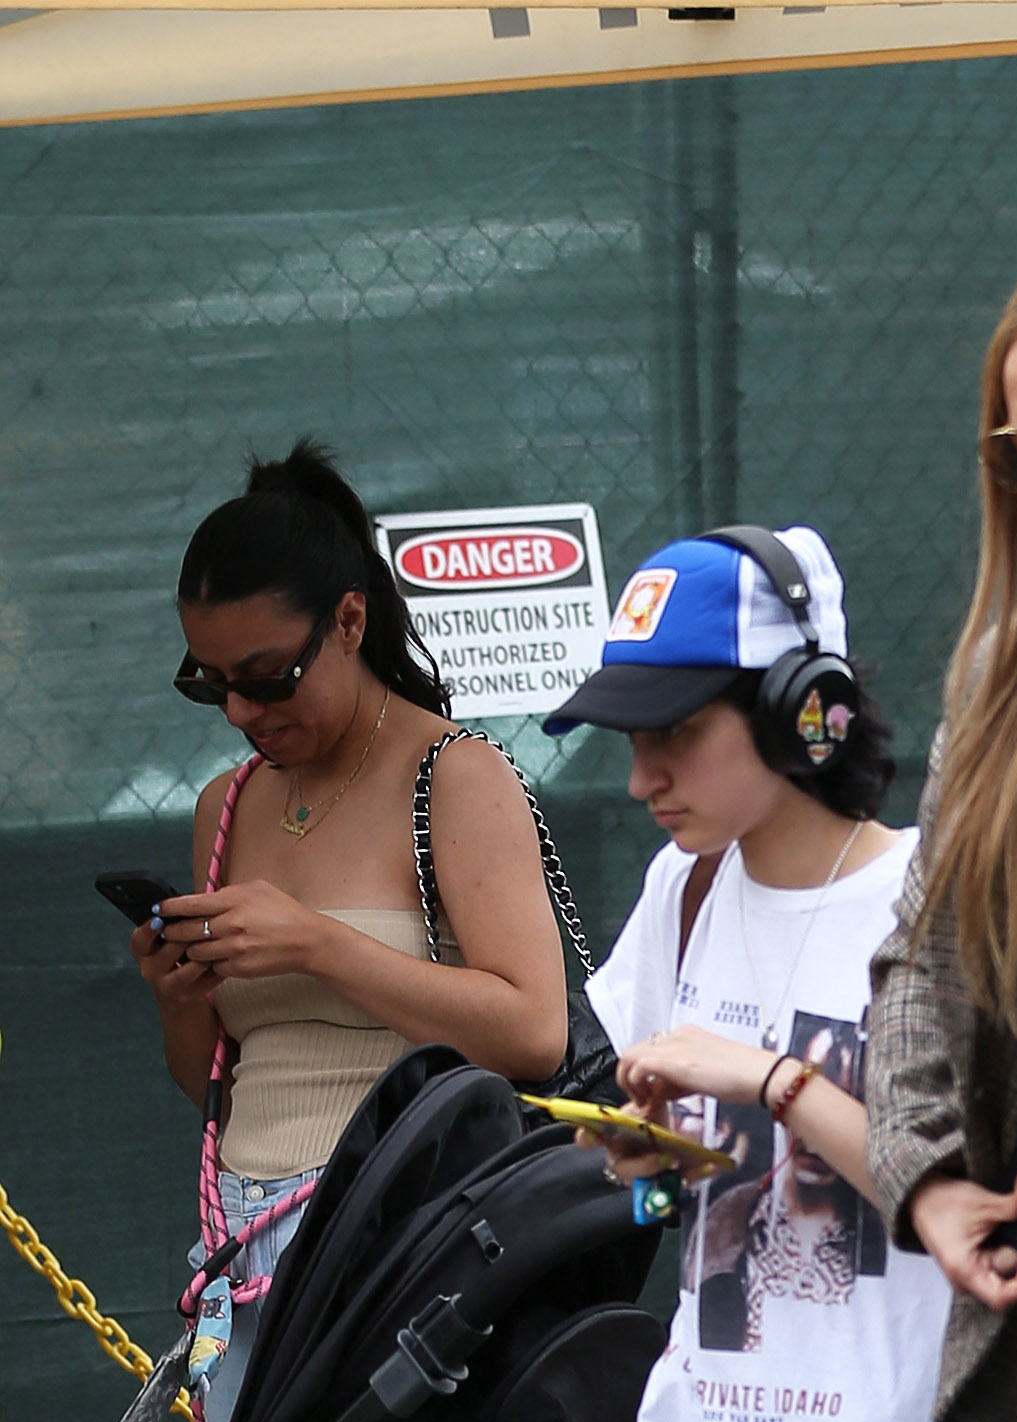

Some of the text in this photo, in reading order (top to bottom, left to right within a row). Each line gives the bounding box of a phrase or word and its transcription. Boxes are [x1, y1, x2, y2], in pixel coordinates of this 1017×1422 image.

[422, 538, 556, 579] DANGER
[411, 602, 595, 638] ONSTRUCTION SITE
[440, 642, 567, 669] AUTHORIZED
[445, 667, 593, 697] RSONNEL ONLY
[697, 1380, 842, 1417] RIVATE IDAHO
